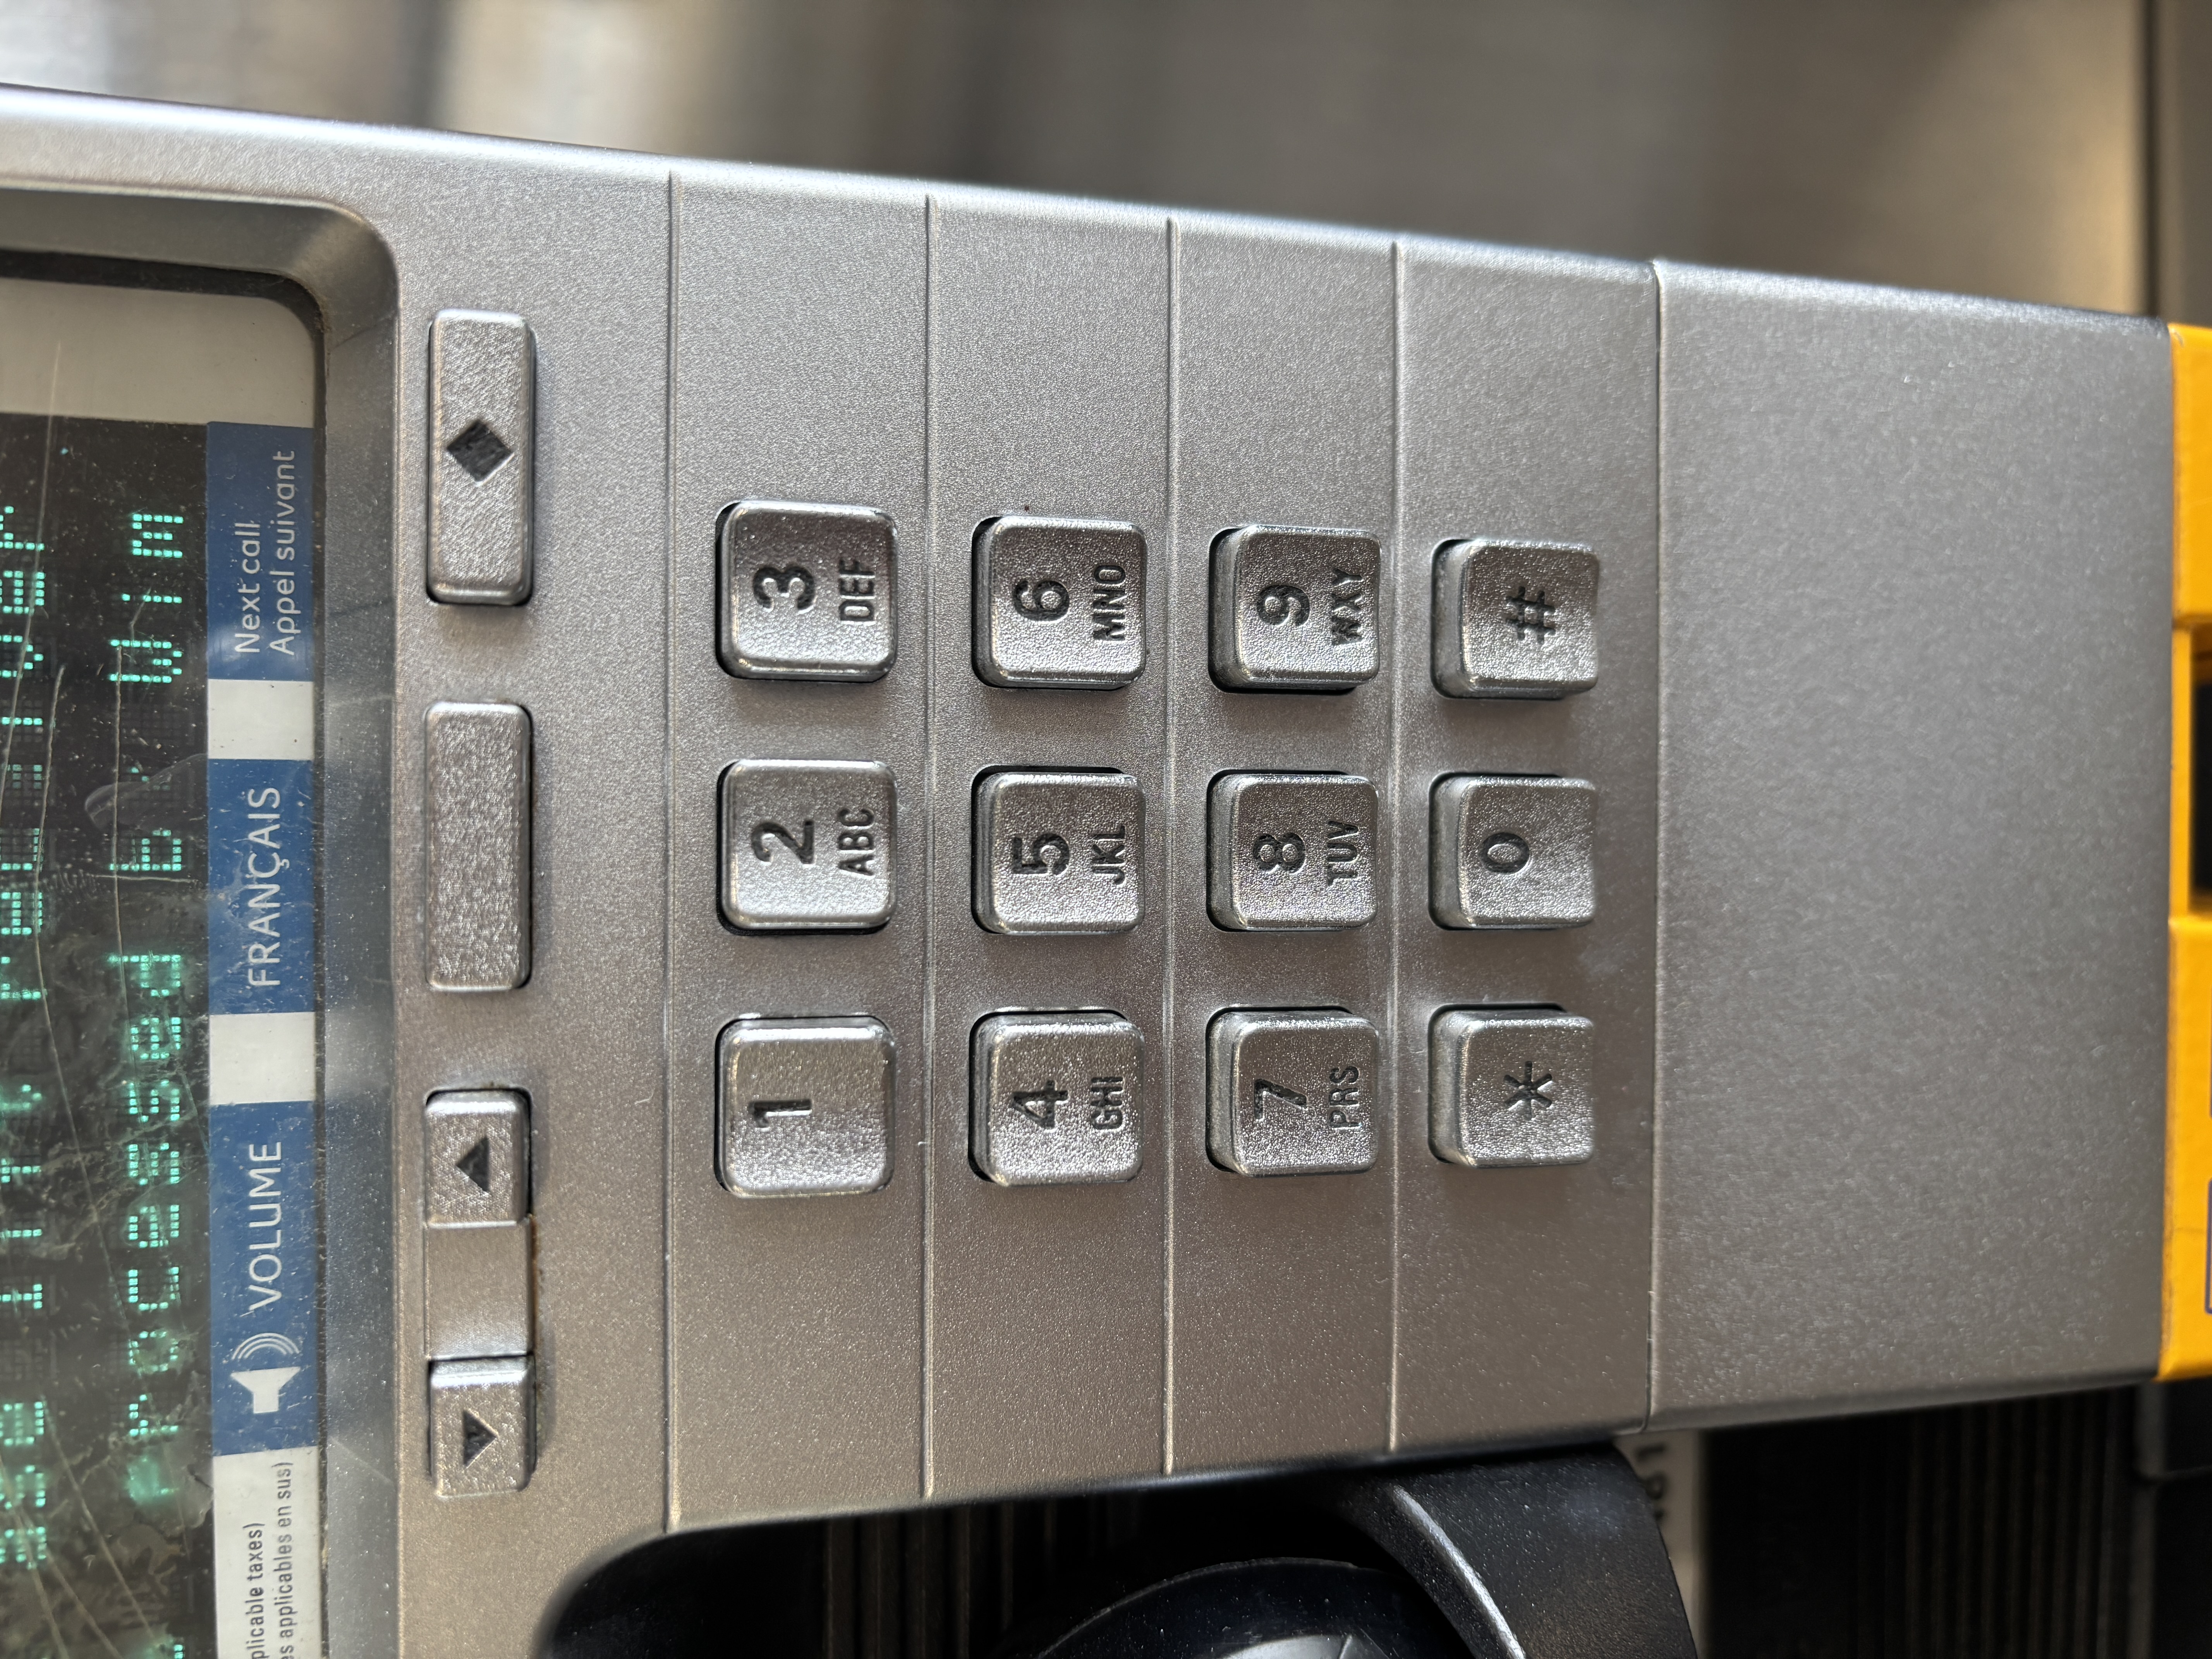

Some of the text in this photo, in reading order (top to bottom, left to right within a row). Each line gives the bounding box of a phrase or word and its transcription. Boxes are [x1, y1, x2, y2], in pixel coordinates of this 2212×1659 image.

[269, 450, 302, 656] Appel suivant
[108, 513, 184, 683] Wim
[234, 523, 261, 653] Next call
[753, 566, 816, 614] 3
[838, 558, 875, 624] DEF
[1013, 579, 1070, 623] 6
[1093, 564, 1126, 641] MNO
[1257, 584, 1311, 626] 9
[1331, 568, 1363, 646] WXY
[751, 821, 814, 865] 2
[838, 807, 874, 878] ABC
[1011, 833, 1070, 876] 5
[1091, 825, 1125, 885] JKL
[1253, 831, 1306, 875] 8
[1327, 820, 1359, 888] TUV
[1480, 831, 1530, 875] 0
[247, 787, 290, 988] FRANÇAIS
[749, 1099, 812, 1132] 1
[1012, 1080, 1070, 1132] 4
[1090, 1077, 1124, 1131] GHI
[1254, 1078, 1309, 1122] 7
[1328, 1066, 1361, 1130] PRS
[248, 1142, 282, 1310] VOLUME
[271, 1462, 294, 1500] sus)
[278, 1506, 293, 1527] en
[242, 1522, 265, 1581] taxes)
[273, 1534, 298, 1638] applicables
